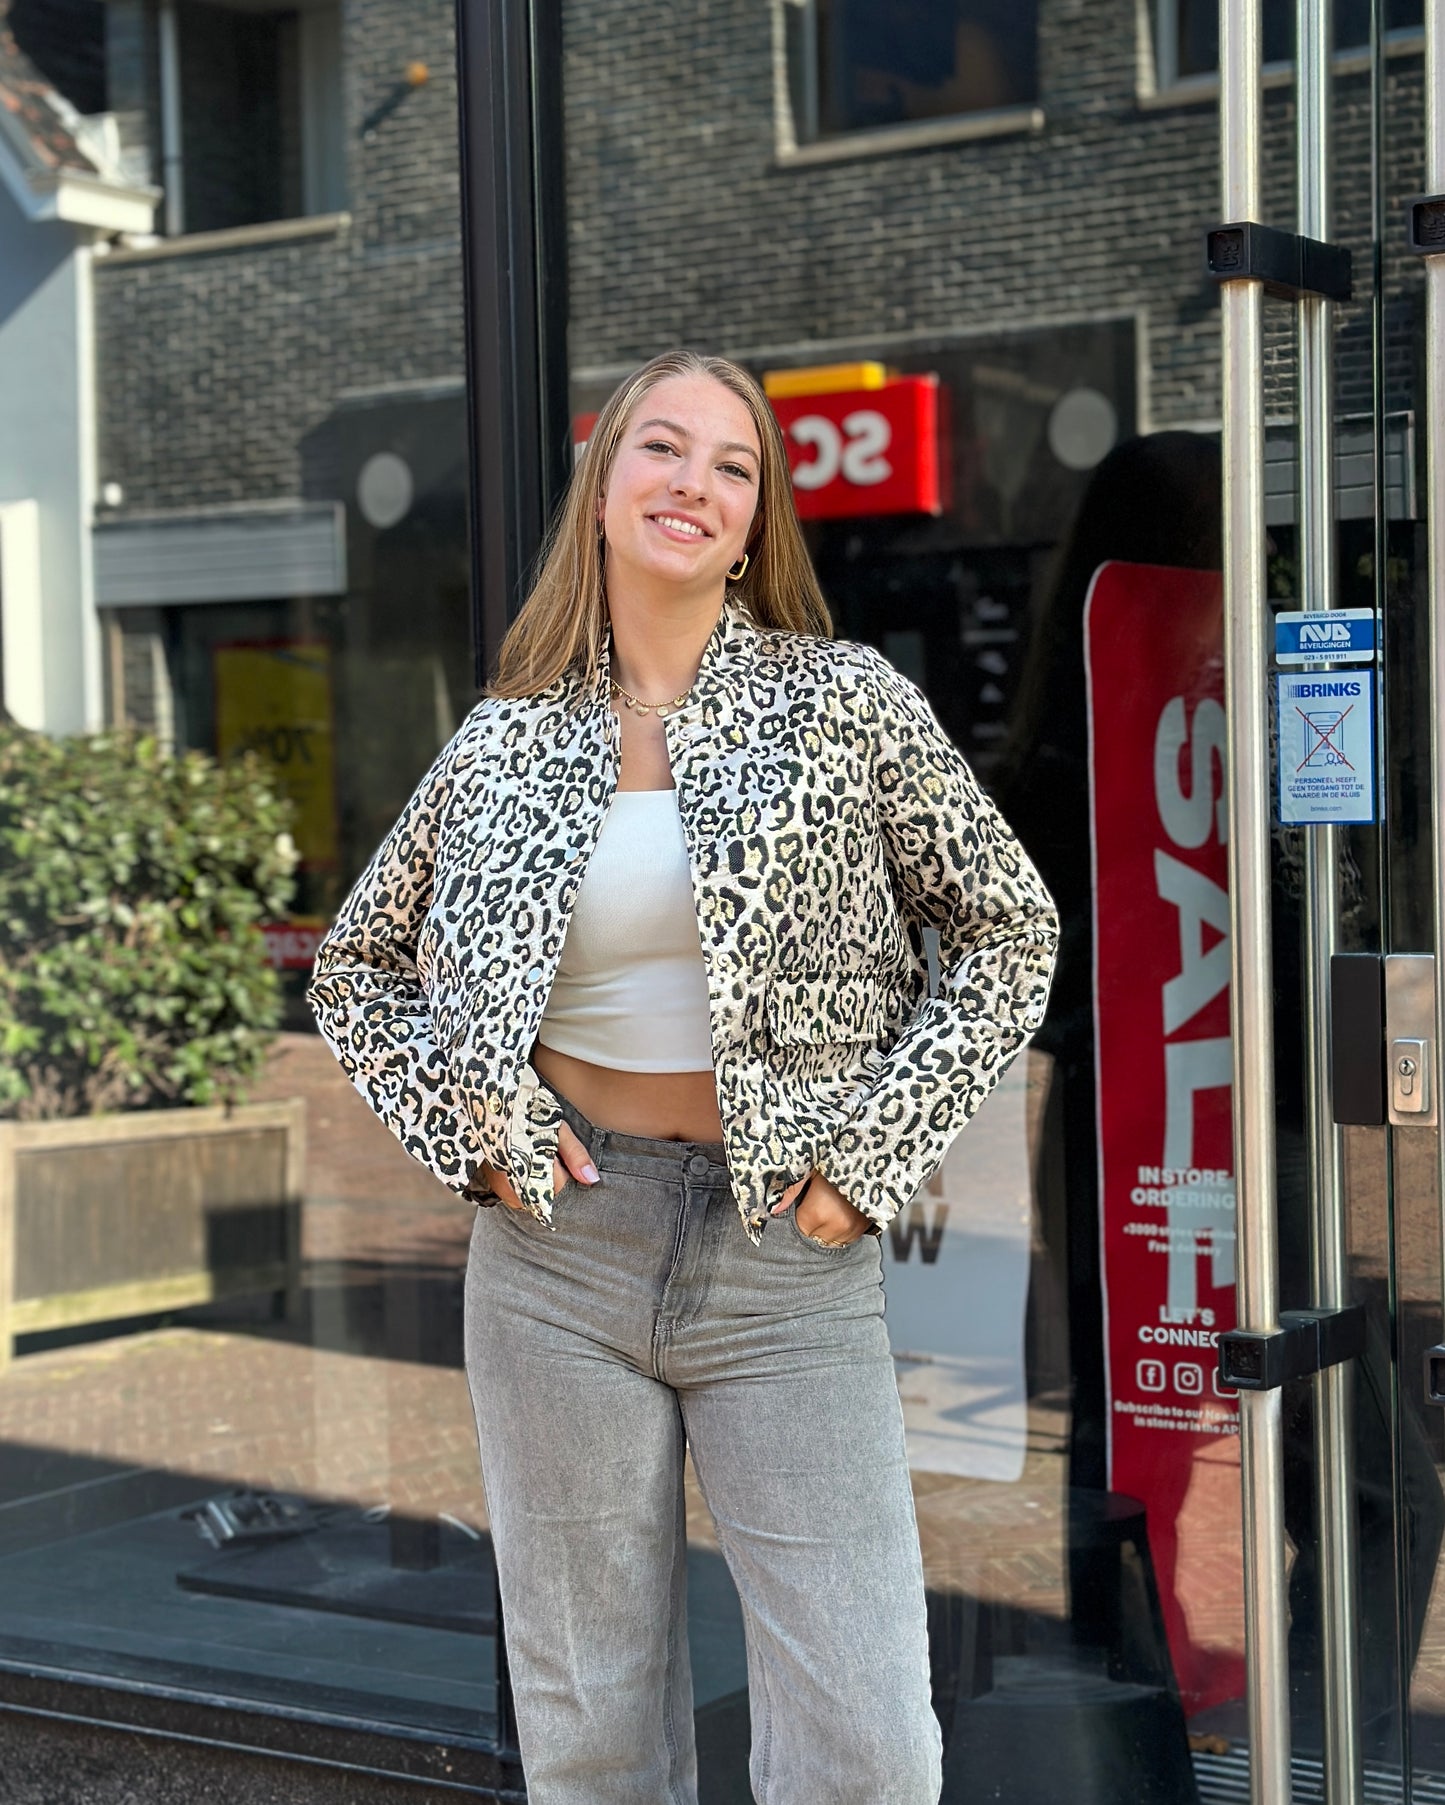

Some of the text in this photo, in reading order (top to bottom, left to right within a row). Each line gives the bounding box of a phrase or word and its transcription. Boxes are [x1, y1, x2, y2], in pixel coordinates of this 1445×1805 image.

[1300, 641, 1351, 650] BEVEILIGINGEN
[1299, 682, 1361, 698] BRINKS
[1130, 1186, 1236, 1210] ORDERING
[1159, 1305, 1215, 1327] LET'S
[1114, 1400, 1171, 1416] Subscribe
[1171, 1407, 1183, 1417] to
[1184, 1409, 1203, 1419] our
[1133, 1415, 1146, 1427] in
[1146, 1417, 1175, 1429] store
[1176, 1421, 1188, 1430] or
[1201, 1422, 1220, 1432] the
[1221, 1424, 1240, 1434] AP
